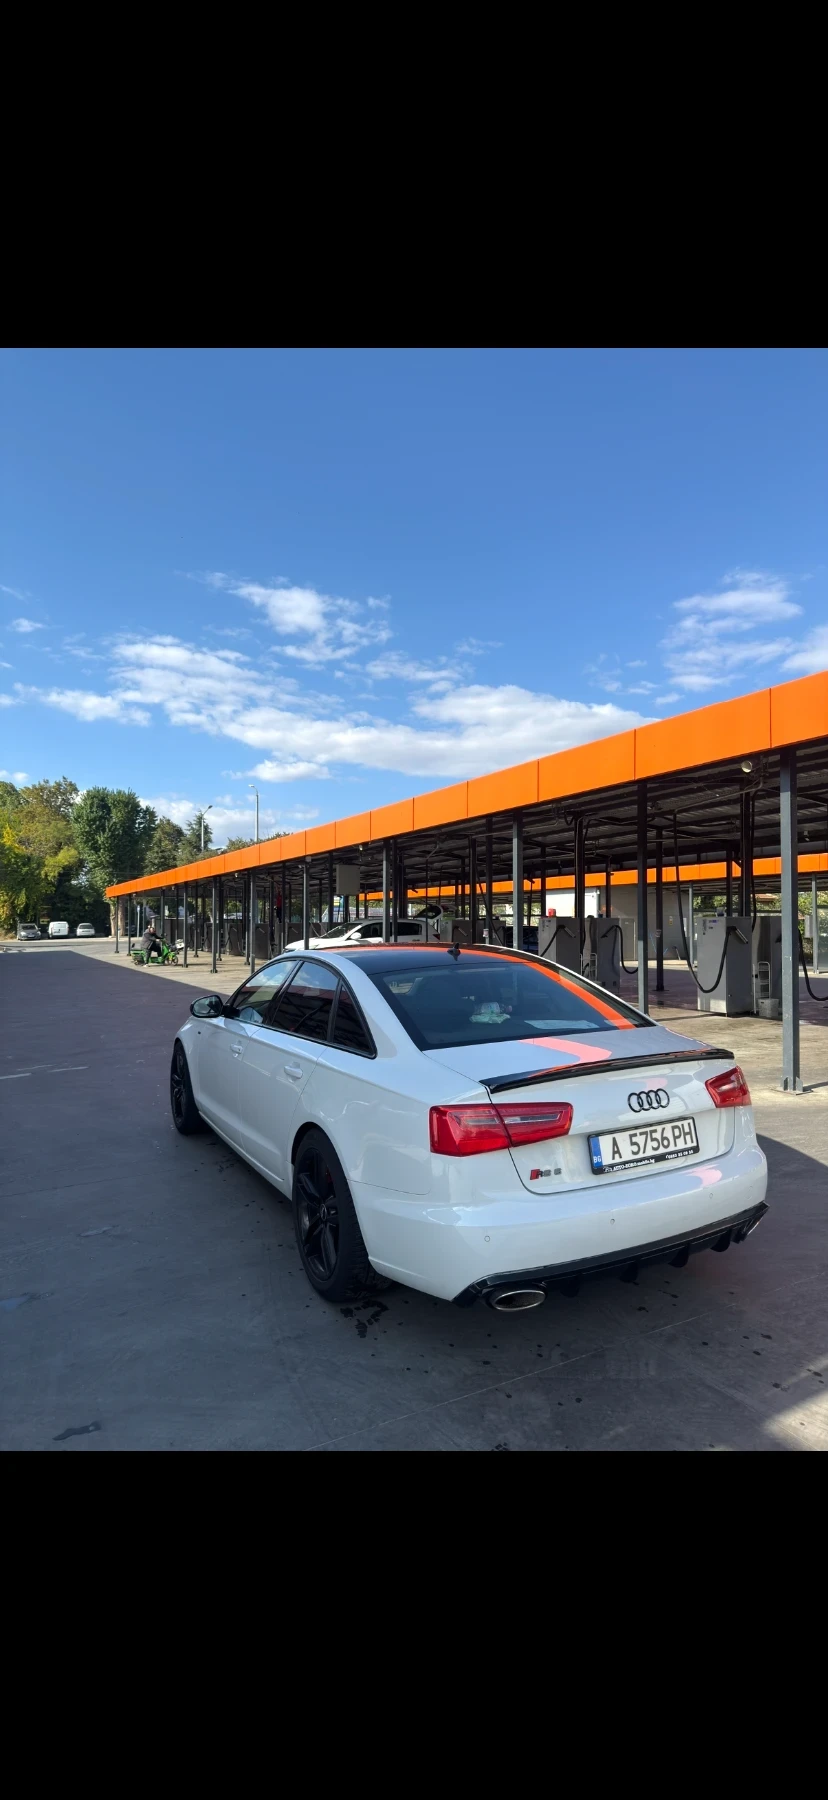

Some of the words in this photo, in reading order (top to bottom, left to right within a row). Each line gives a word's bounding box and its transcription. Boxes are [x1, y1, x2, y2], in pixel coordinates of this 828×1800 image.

[612, 1137, 622, 1160] A
[628, 1127, 671, 1155] 5756
[671, 1122, 694, 1147] PH
[593, 1155, 602, 1163] BG
